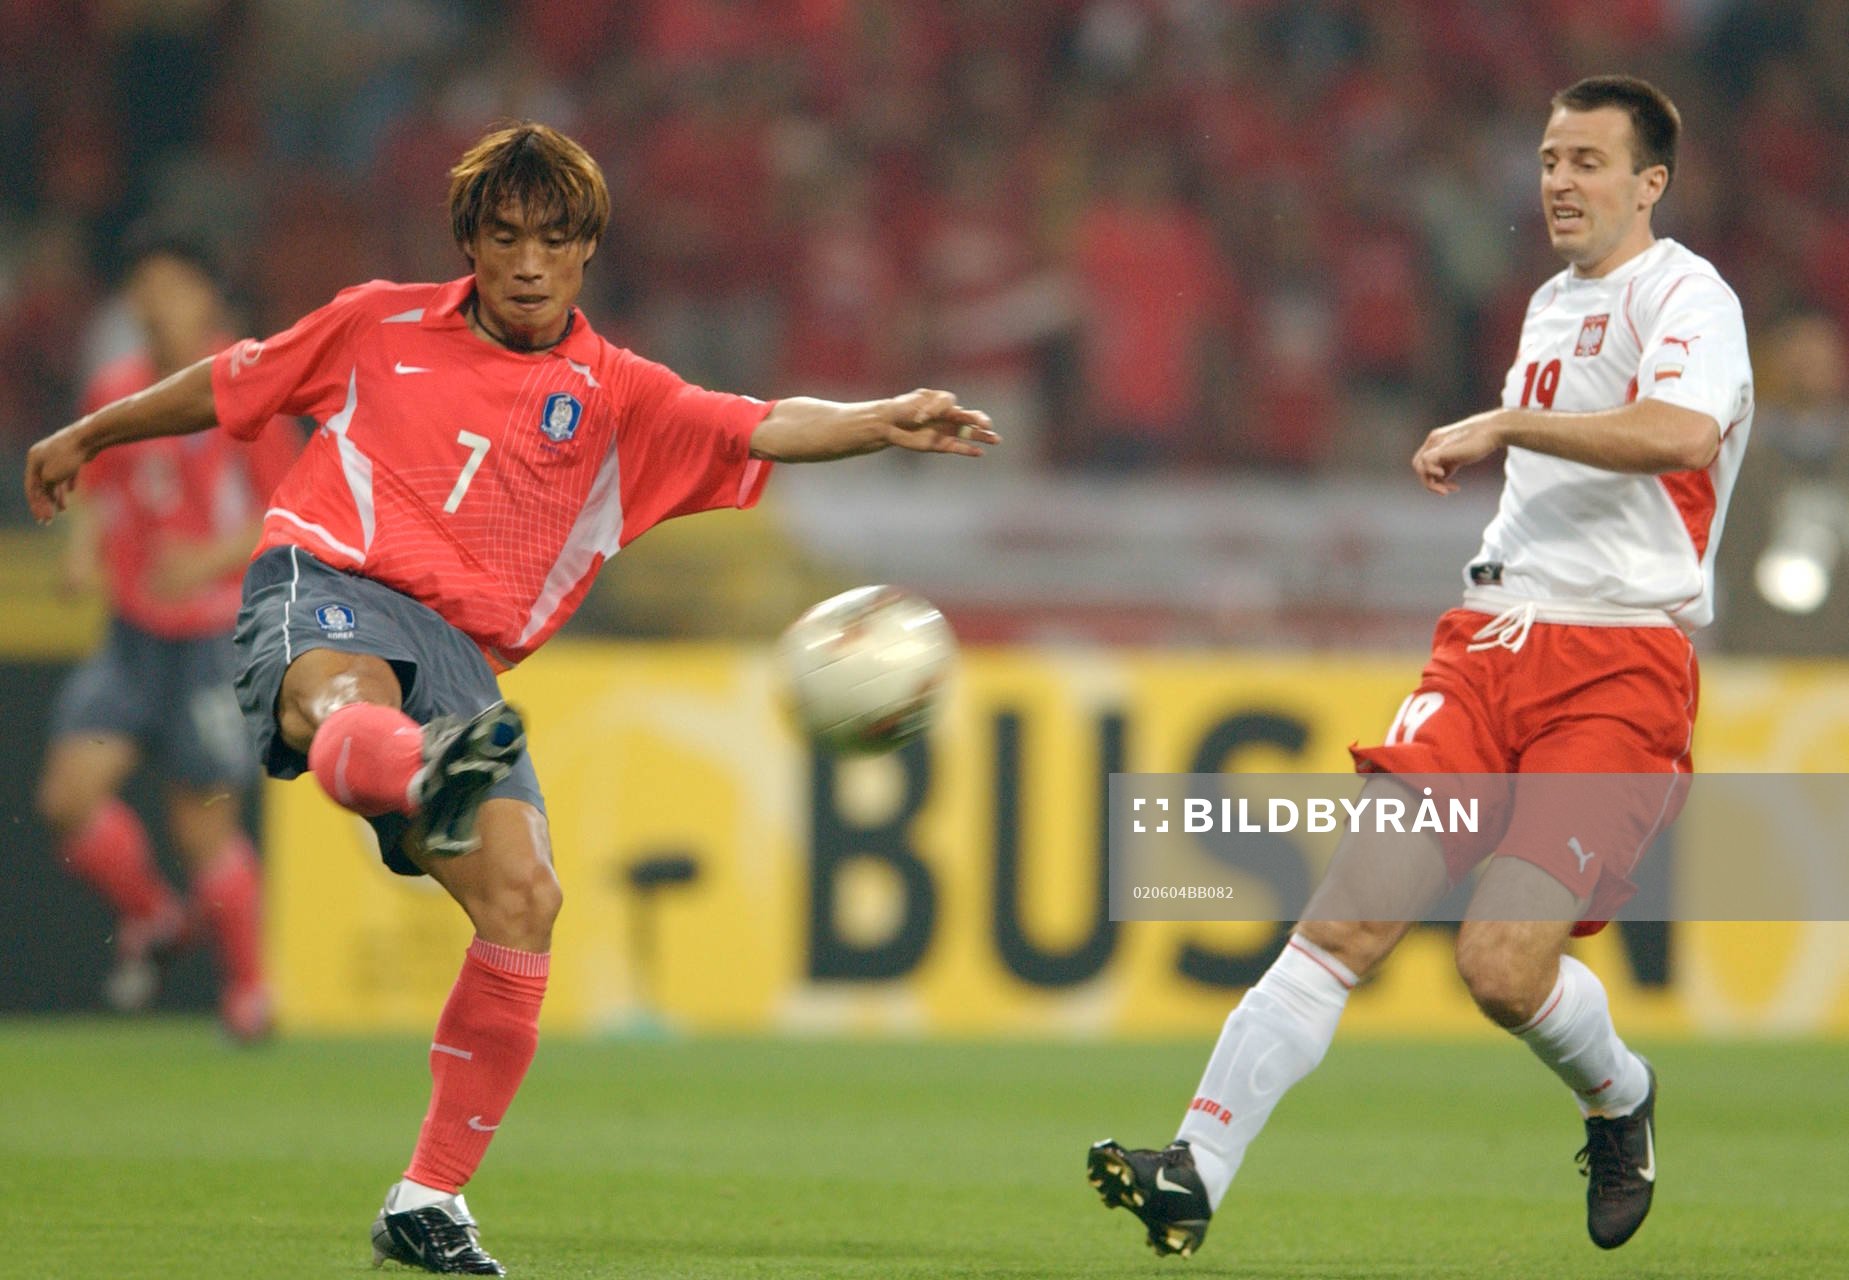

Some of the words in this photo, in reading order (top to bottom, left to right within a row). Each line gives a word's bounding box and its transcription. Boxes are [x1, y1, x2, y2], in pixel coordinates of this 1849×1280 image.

[1520, 358, 1562, 410] 19
[443, 429, 492, 514] 7
[1383, 691, 1445, 747] 19
[807, 706, 1676, 988] BUS
[1187, 1097, 1233, 1126] UMA
